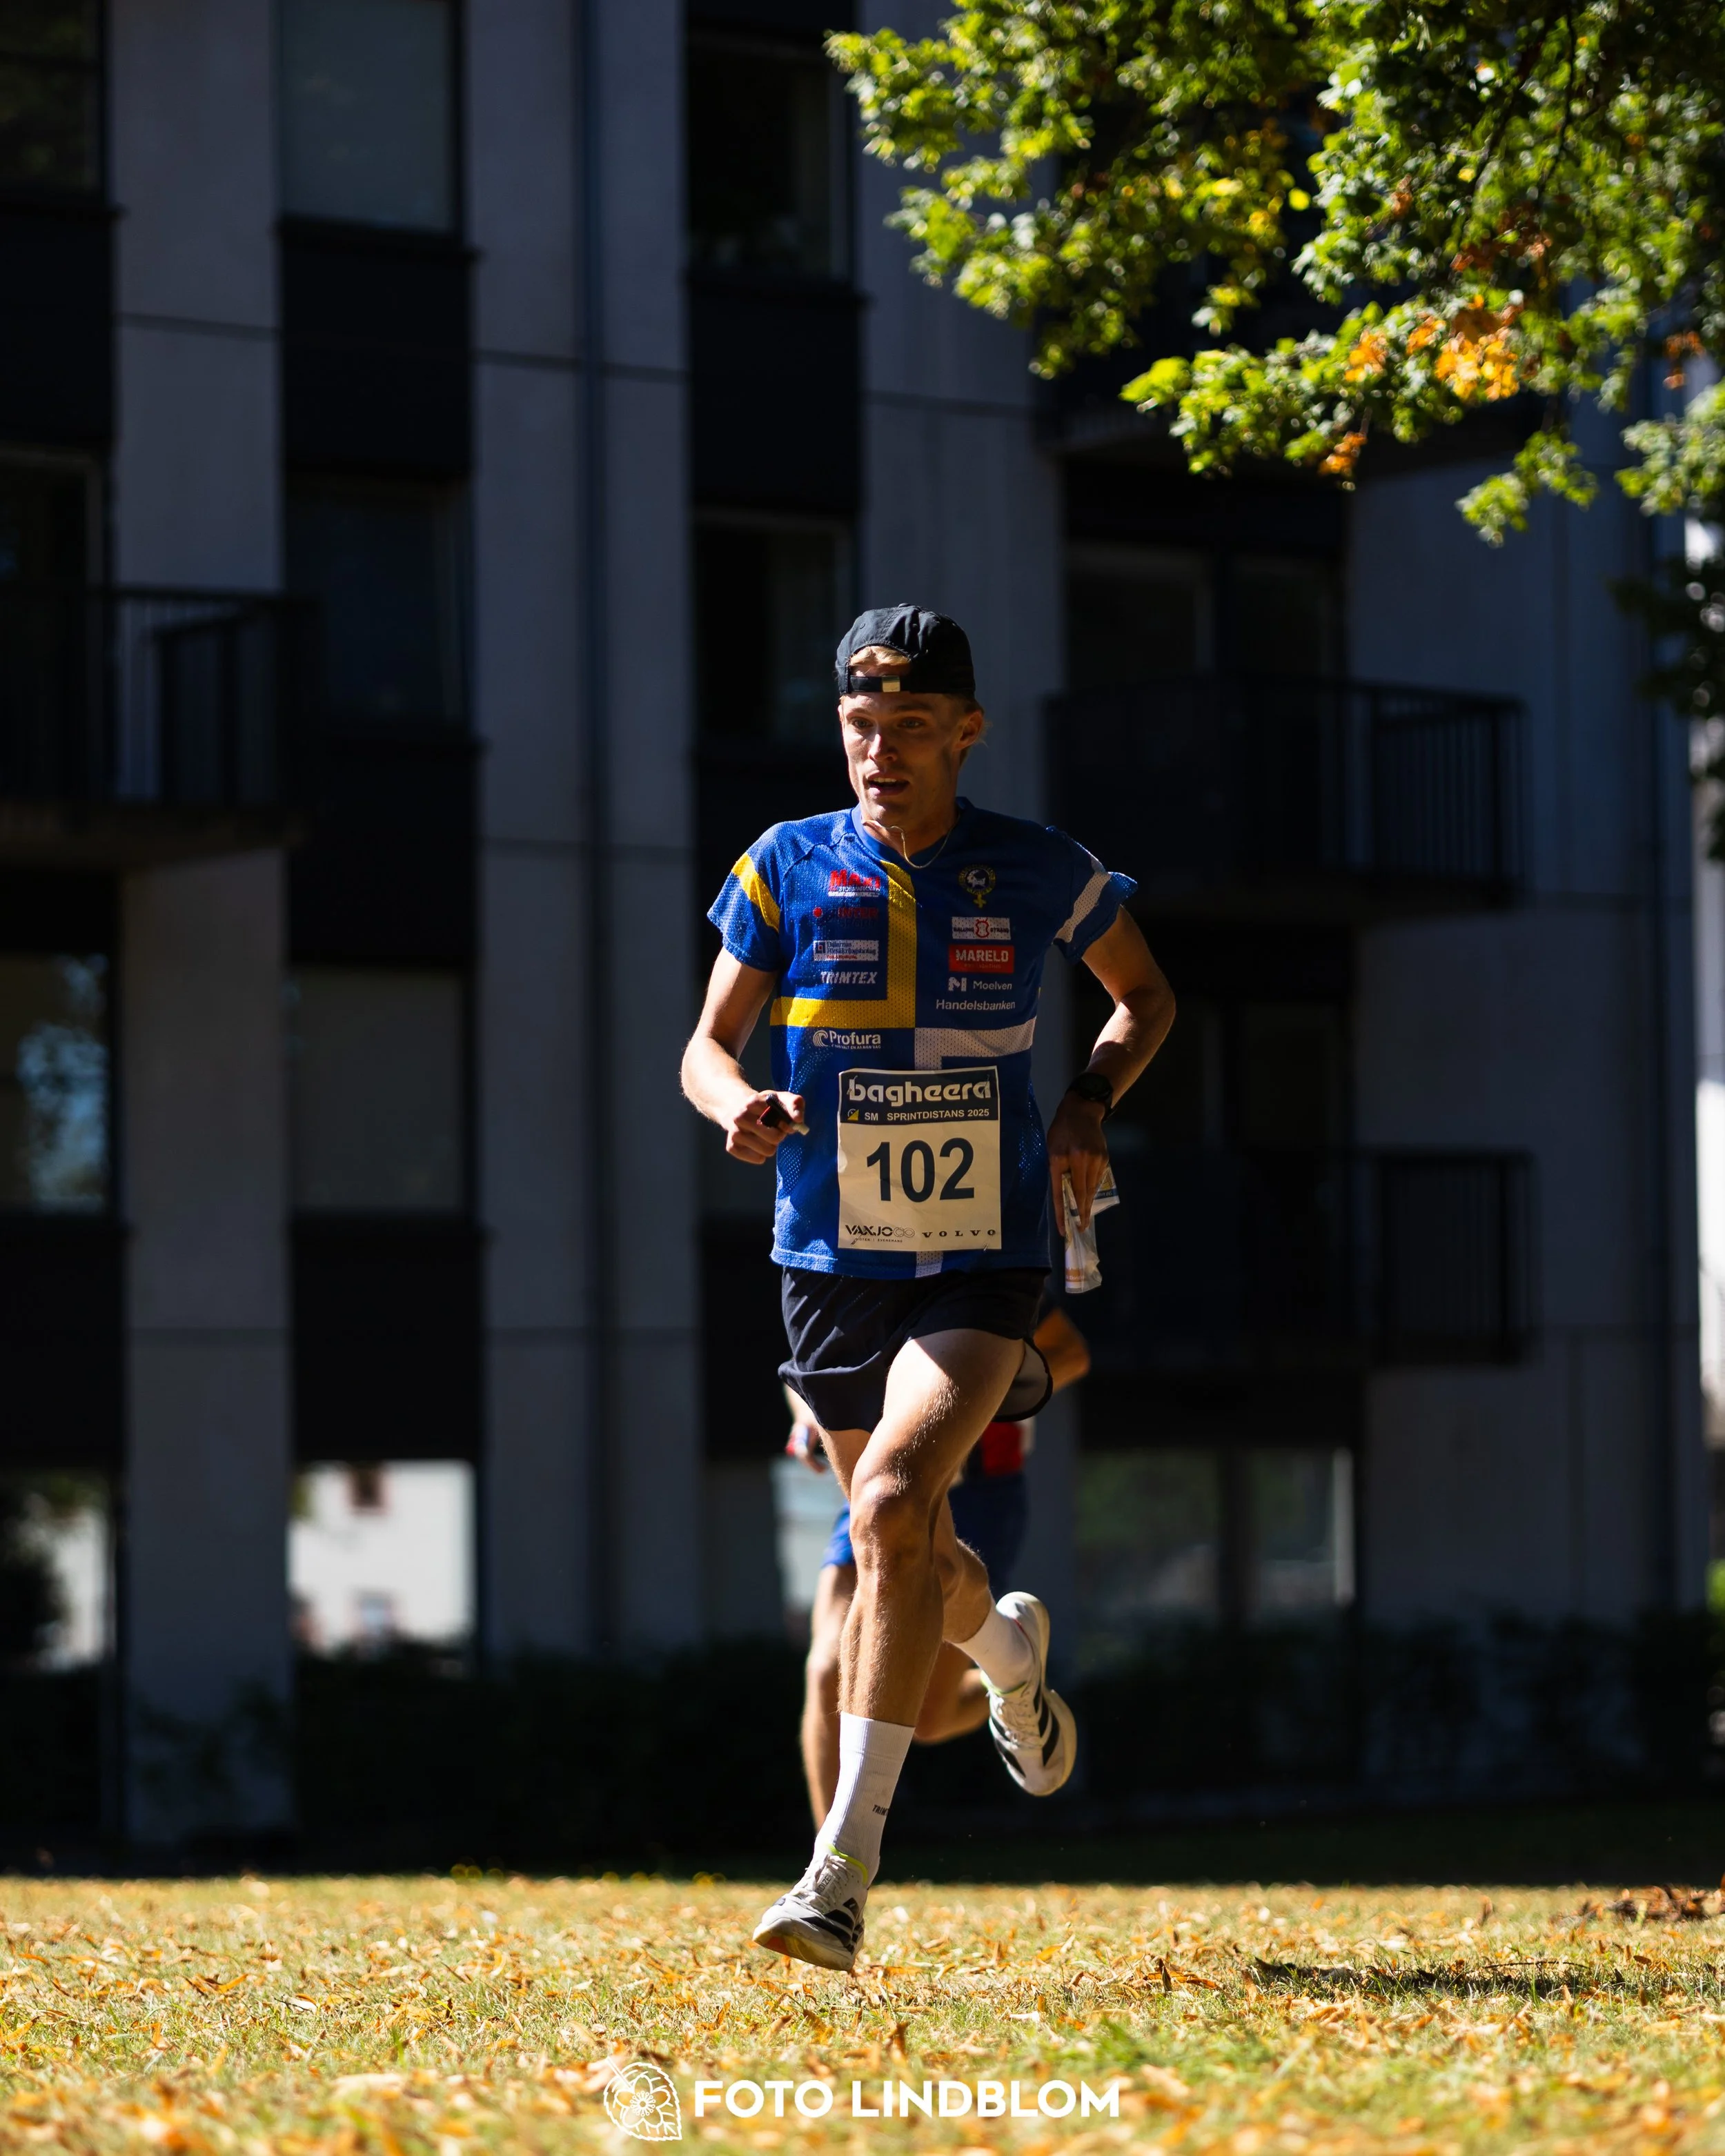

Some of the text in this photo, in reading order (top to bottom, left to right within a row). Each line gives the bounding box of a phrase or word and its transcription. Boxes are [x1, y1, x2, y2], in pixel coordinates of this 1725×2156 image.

[821, 971, 878, 985] TRIMTEX
[973, 980, 1012, 990] Moelven
[936, 999, 1016, 1011] Handelsbanken
[829, 1030, 881, 1045] Profura
[848, 1078, 991, 1107] bagheera
[865, 1109, 989, 1121] SM SPRINTDISTANS 2025
[867, 1137, 975, 1203] 102
[922, 1229, 996, 1238] VOLVO
